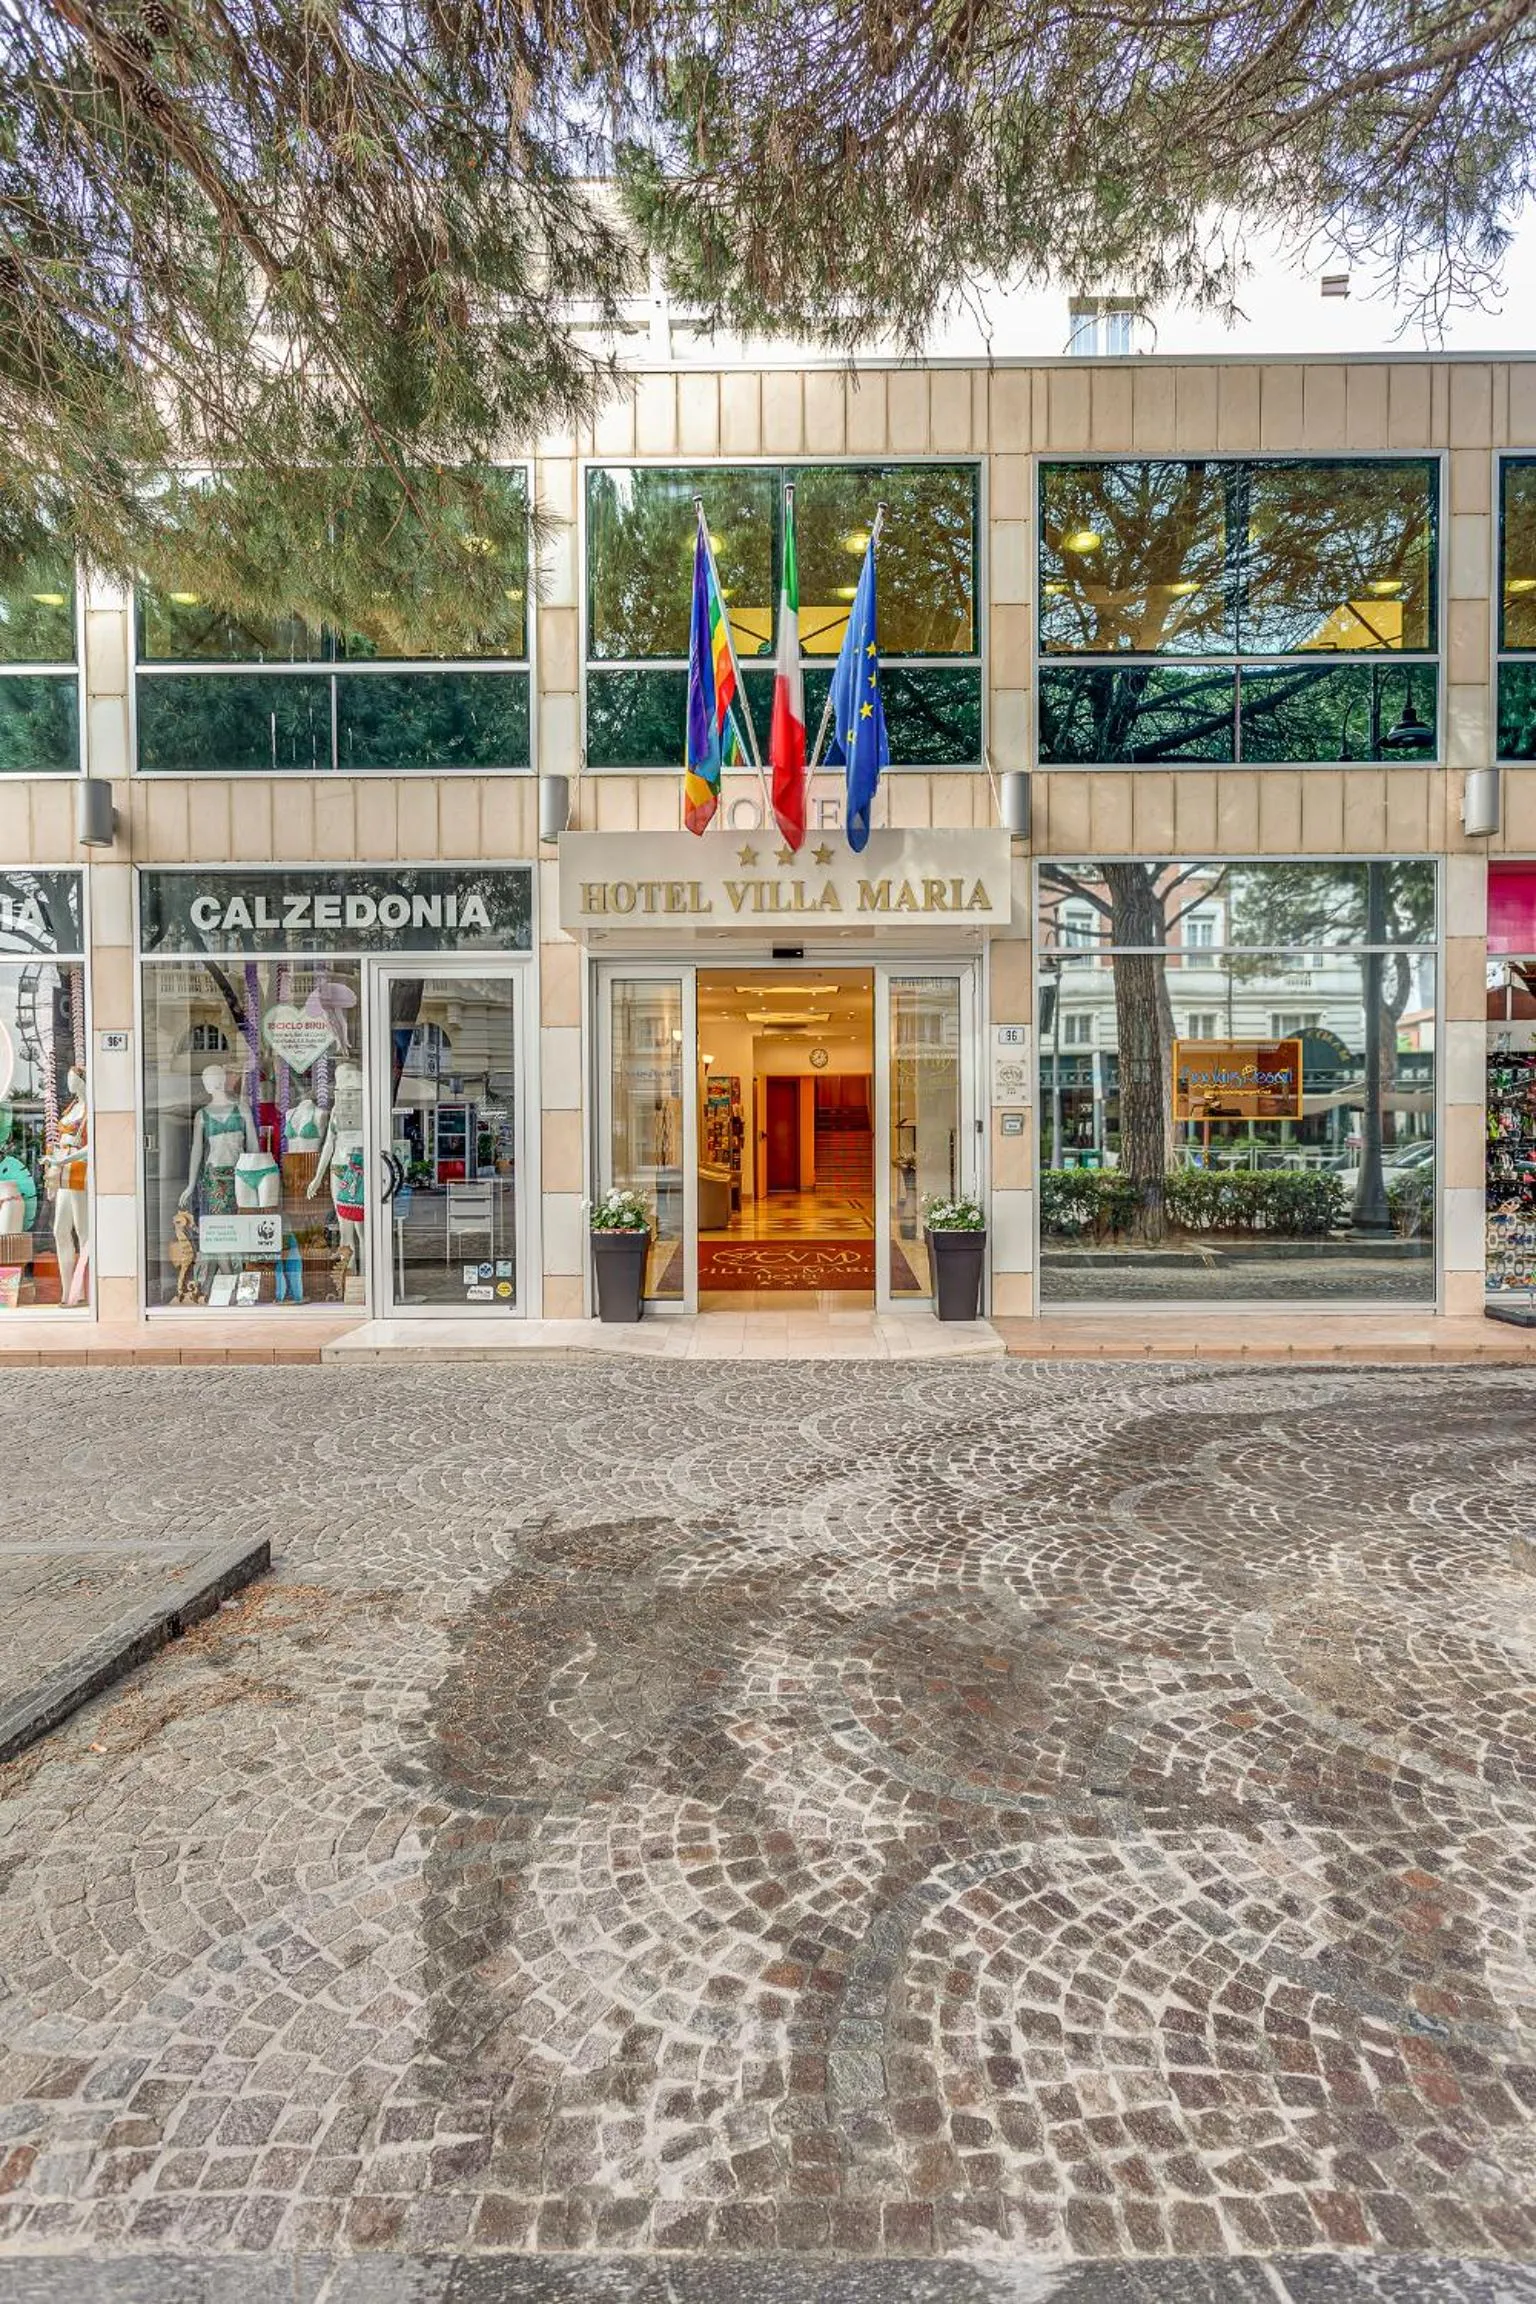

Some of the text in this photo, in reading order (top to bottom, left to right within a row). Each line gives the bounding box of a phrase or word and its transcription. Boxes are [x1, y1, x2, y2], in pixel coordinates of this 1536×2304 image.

[190, 895, 492, 930] CALZEDONIA
[579, 878, 993, 914] HOTEL VILLA MARIA
[1006, 1030, 1018, 1041] 96
